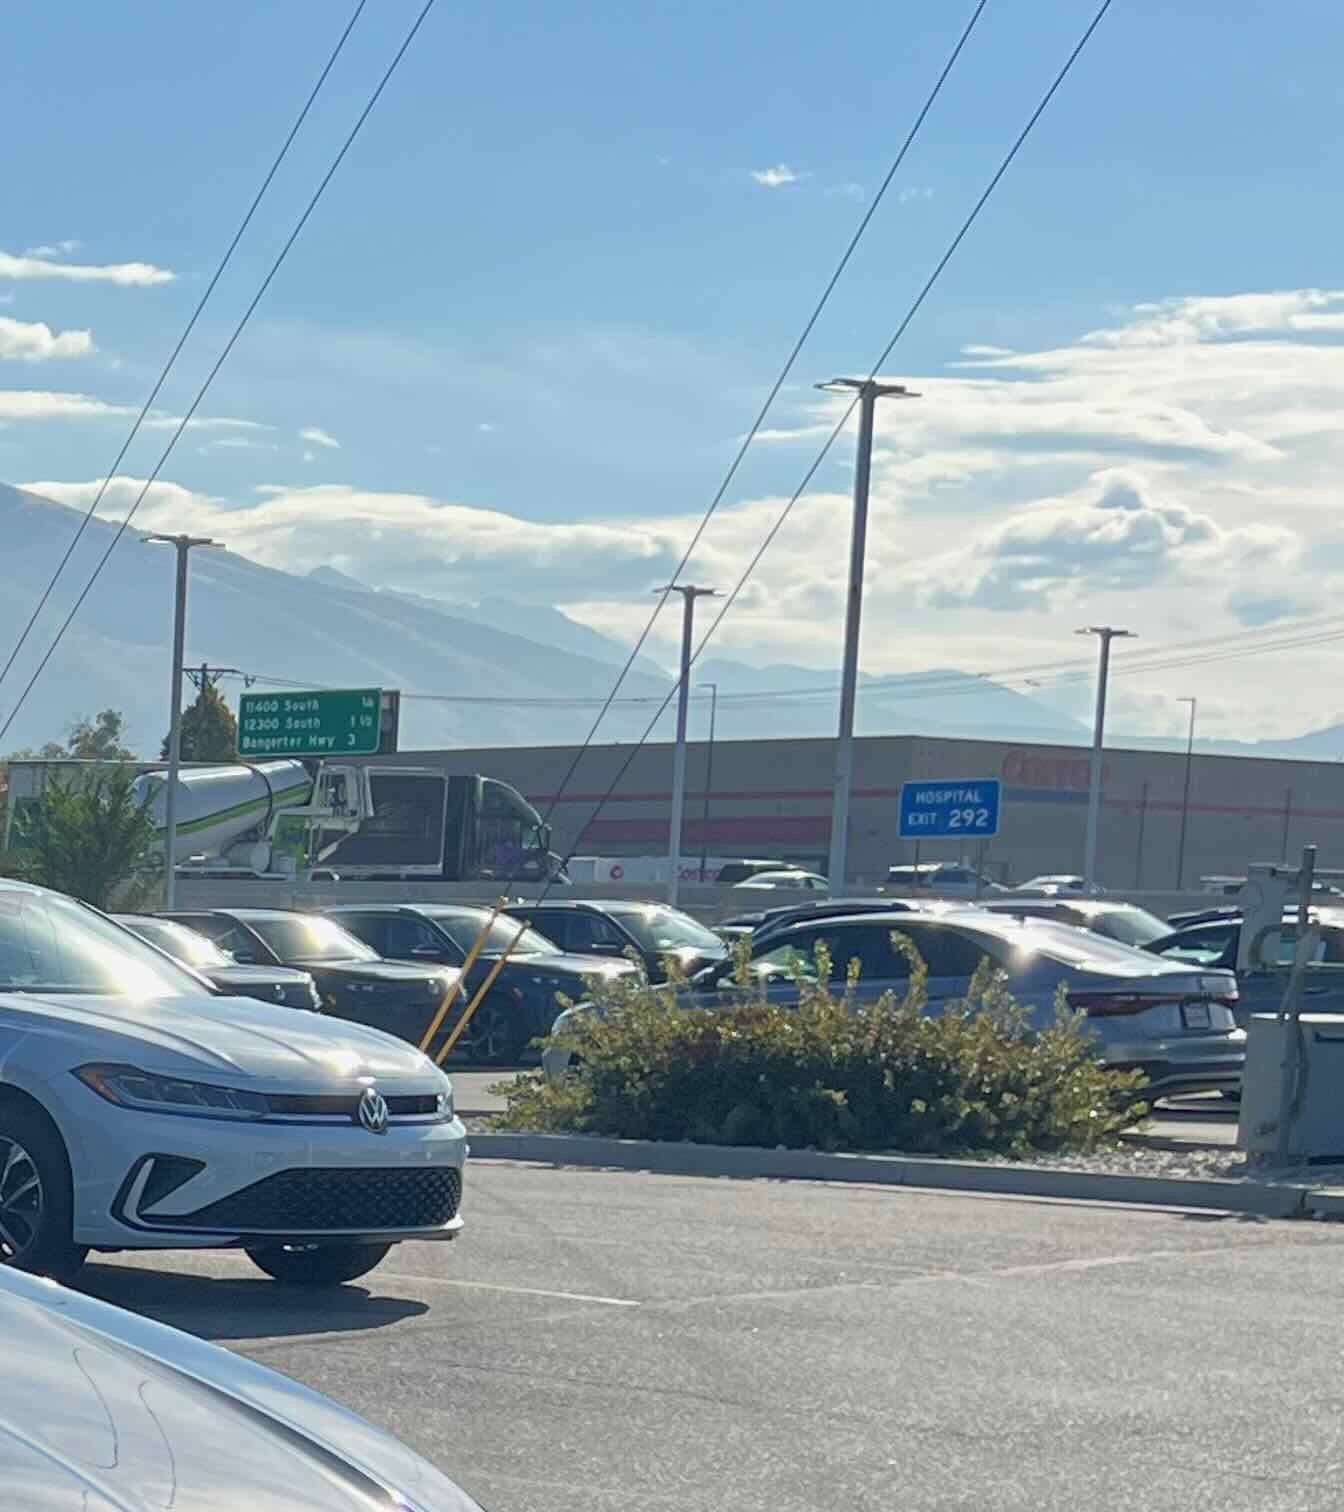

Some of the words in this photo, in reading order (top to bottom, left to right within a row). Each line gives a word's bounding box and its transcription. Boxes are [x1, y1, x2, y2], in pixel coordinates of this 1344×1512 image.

[283, 699, 319, 712] South
[244, 717, 280, 731] 12300
[285, 716, 321, 729] South
[242, 735, 302, 750] Bangerter
[308, 735, 336, 748] Hwy
[347, 733, 356, 746] 3
[915, 788, 984, 805] HOSPITAL
[908, 812, 937, 825] EXIT
[949, 808, 988, 828] 292
